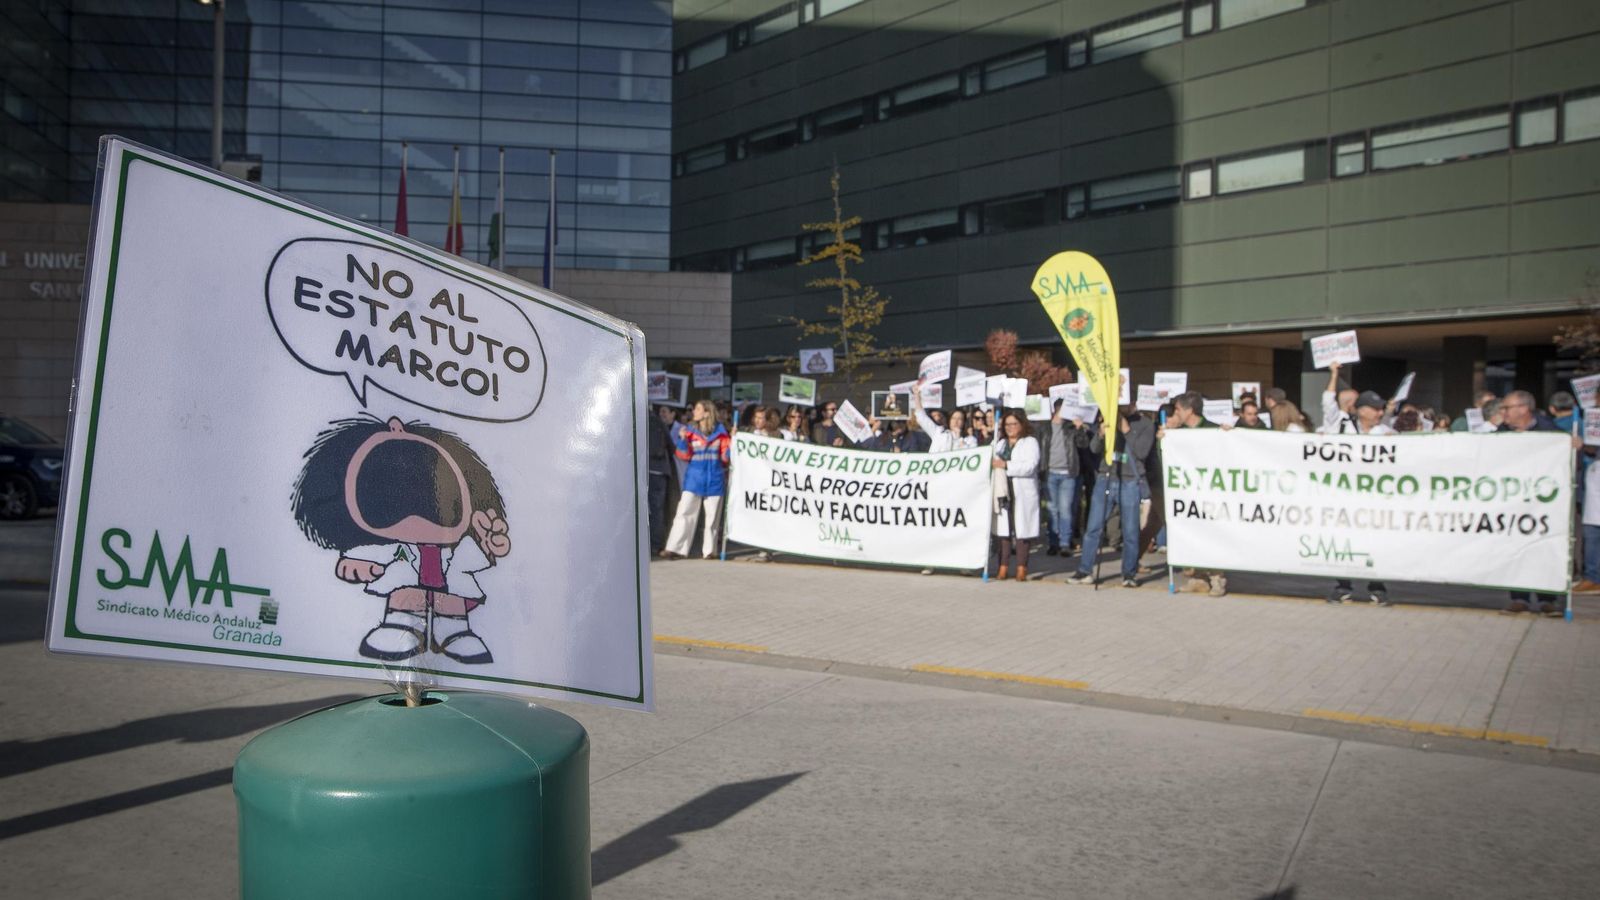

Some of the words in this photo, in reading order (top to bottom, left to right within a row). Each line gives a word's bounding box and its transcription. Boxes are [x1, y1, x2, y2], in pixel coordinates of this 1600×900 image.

[347, 254, 413, 299] NO
[429, 288, 478, 323] AL
[1038, 271, 1103, 299] SMA
[294, 276, 530, 373] ESTATUTO
[335, 329, 499, 401] MARCO!
[737, 439, 769, 461] POR
[774, 445, 803, 465] UN
[805, 452, 902, 476] ESTATUTO
[906, 454, 981, 476] PROPIO
[1303, 442, 1352, 462] POR
[1361, 444, 1396, 463] UN
[771, 470, 791, 489] DE
[794, 474, 814, 493] LA
[820, 477, 928, 500] PROFESIÓN
[1167, 465, 1297, 495] ESTATUTO
[1306, 471, 1420, 497] MARCO
[1430, 475, 1560, 503] PROPIO
[745, 489, 811, 517] MÉDICA
[815, 501, 824, 518] Y
[830, 501, 968, 528] FACULTATIVA
[1173, 499, 1231, 521] PARA
[1240, 503, 1313, 525] LAS/OS
[1321, 506, 1549, 536] FACULTATIVAS/OS
[818, 523, 860, 546] SMA
[1299, 533, 1369, 562] SMA
[97, 528, 270, 608] SMA
[97, 599, 159, 617] Sindicato
[163, 608, 209, 624] Médico
[213, 613, 262, 630] Andaluz
[212, 625, 282, 646] Granada
